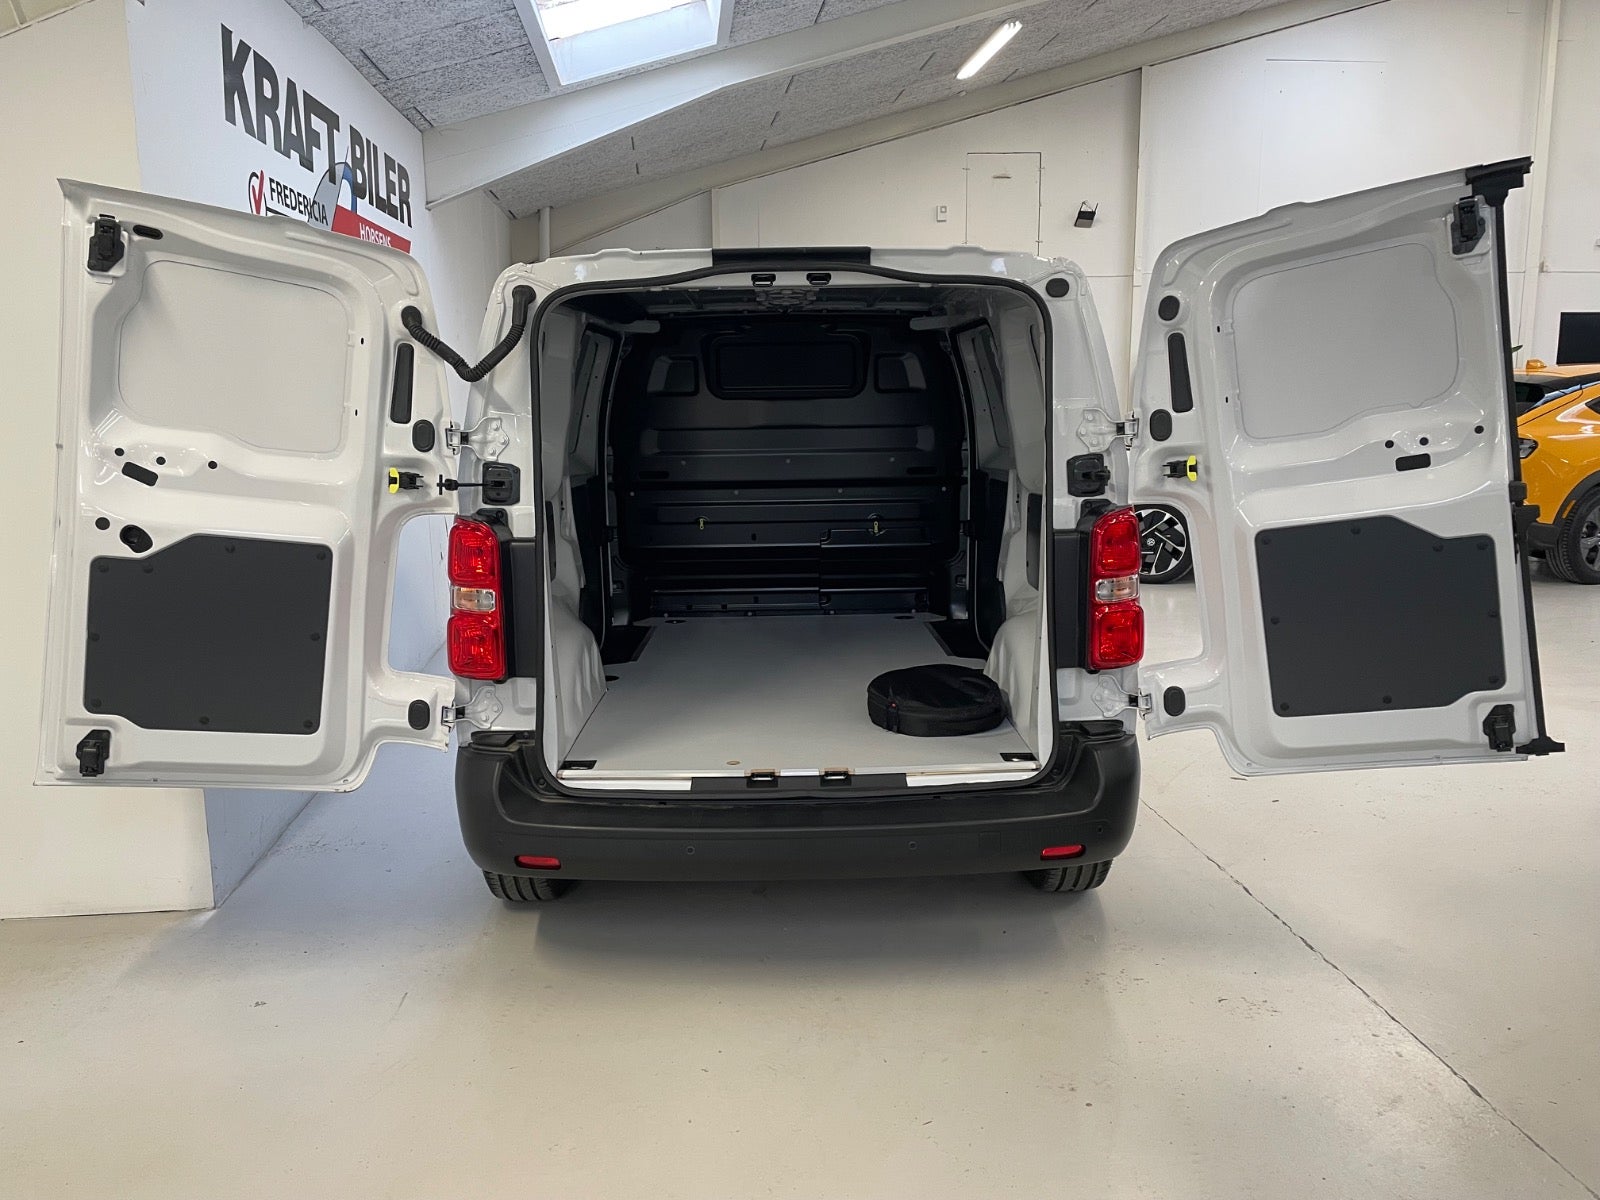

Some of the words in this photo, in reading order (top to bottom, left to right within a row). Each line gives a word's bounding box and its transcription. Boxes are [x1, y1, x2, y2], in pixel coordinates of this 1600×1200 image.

[221, 23, 340, 185] KRAFT
[349, 125, 412, 228] BILER
[268, 177, 328, 225] FREDERICIA
